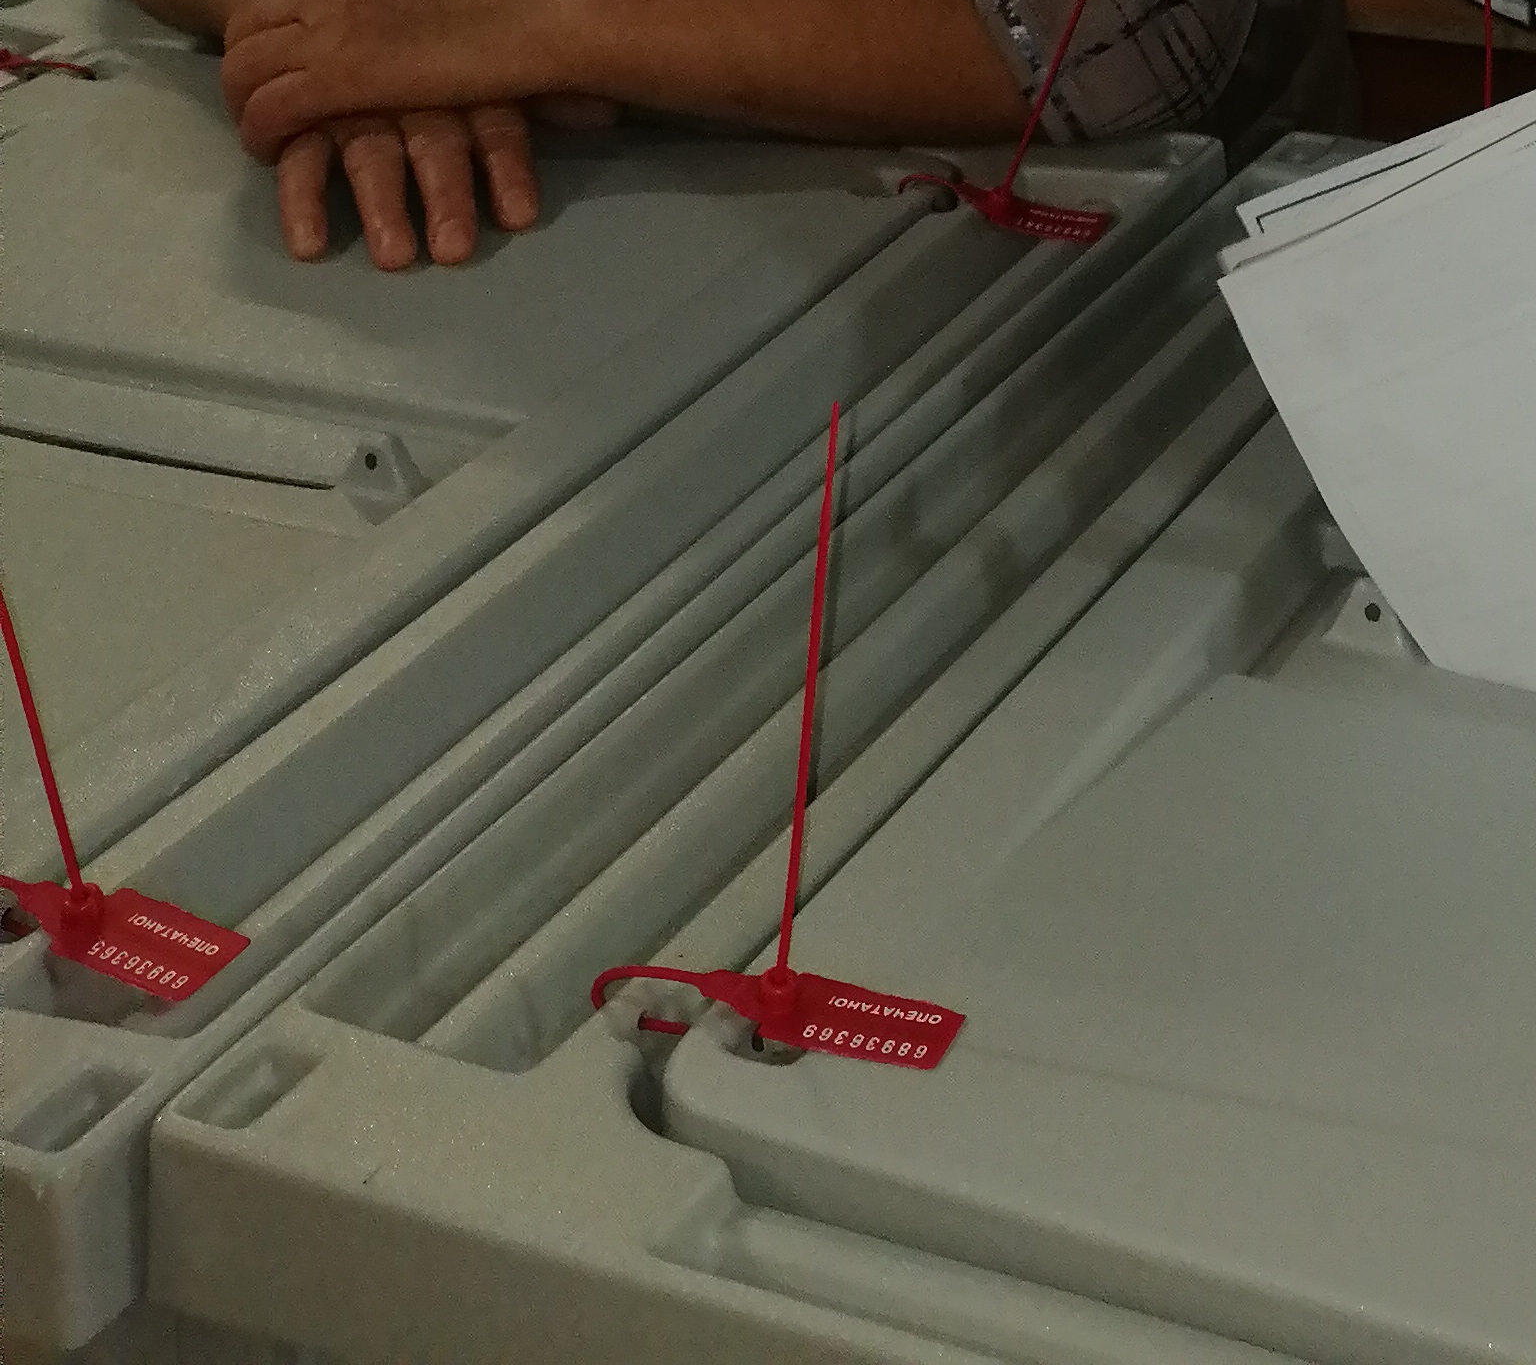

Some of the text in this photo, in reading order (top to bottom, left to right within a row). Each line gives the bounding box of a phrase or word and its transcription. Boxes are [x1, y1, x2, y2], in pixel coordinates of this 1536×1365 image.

[127, 912, 220, 956] ОПЕЧАТАНО!
[87, 940, 190, 990] 68936365
[827, 995, 943, 1025] ОПЕЧАТАНО!
[802, 1024, 928, 1059] 68936369
